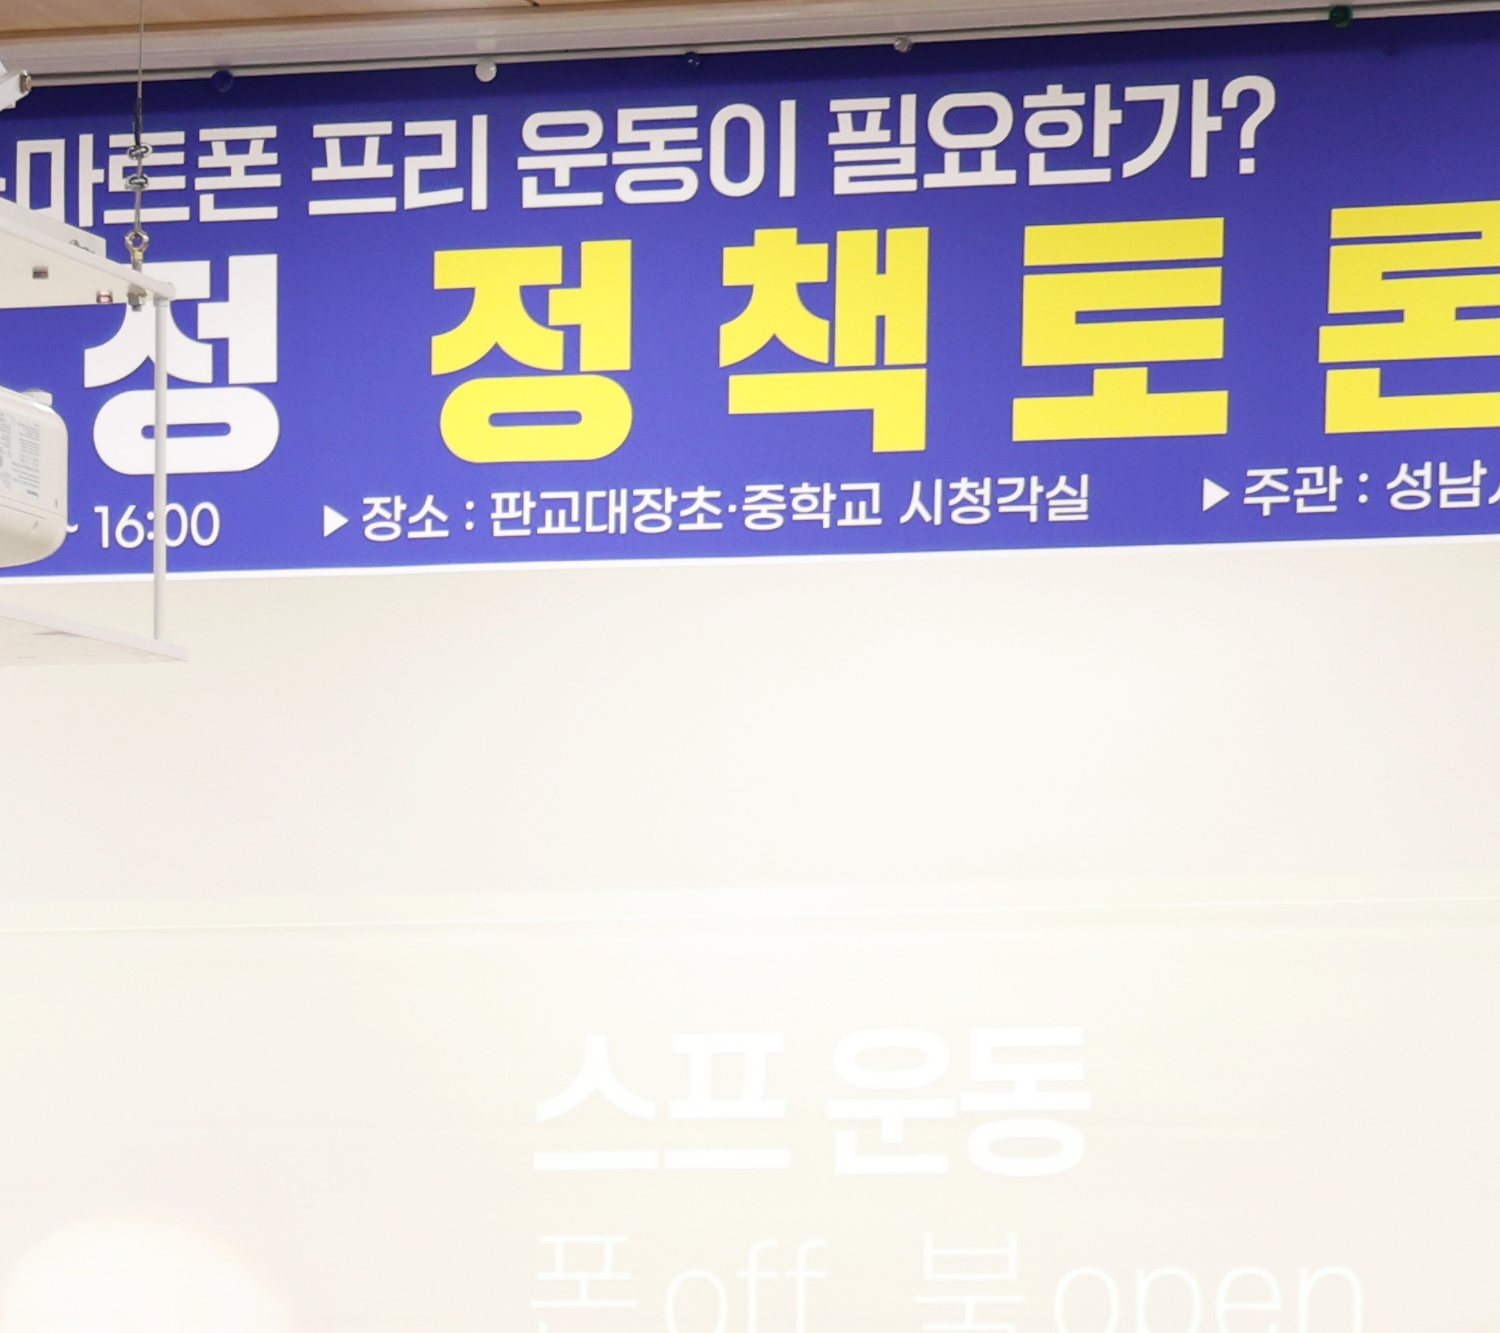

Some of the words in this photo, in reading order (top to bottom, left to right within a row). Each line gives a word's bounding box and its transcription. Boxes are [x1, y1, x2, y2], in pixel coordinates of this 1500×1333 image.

[308, 114, 488, 215] 프리
[517, 99, 796, 209] 운동이
[828, 75, 1275, 195] 필요한가?
[362, 494, 450, 542] 장소
[490, 481, 883, 537] 판교대장초·중학교
[899, 473, 1089, 526] 시청각실
[1243, 464, 1343, 517] 주관
[93, 502, 220, 549] 16:00
[533, 1033, 791, 1171] 스프
[827, 1026, 1092, 1177] 운동
